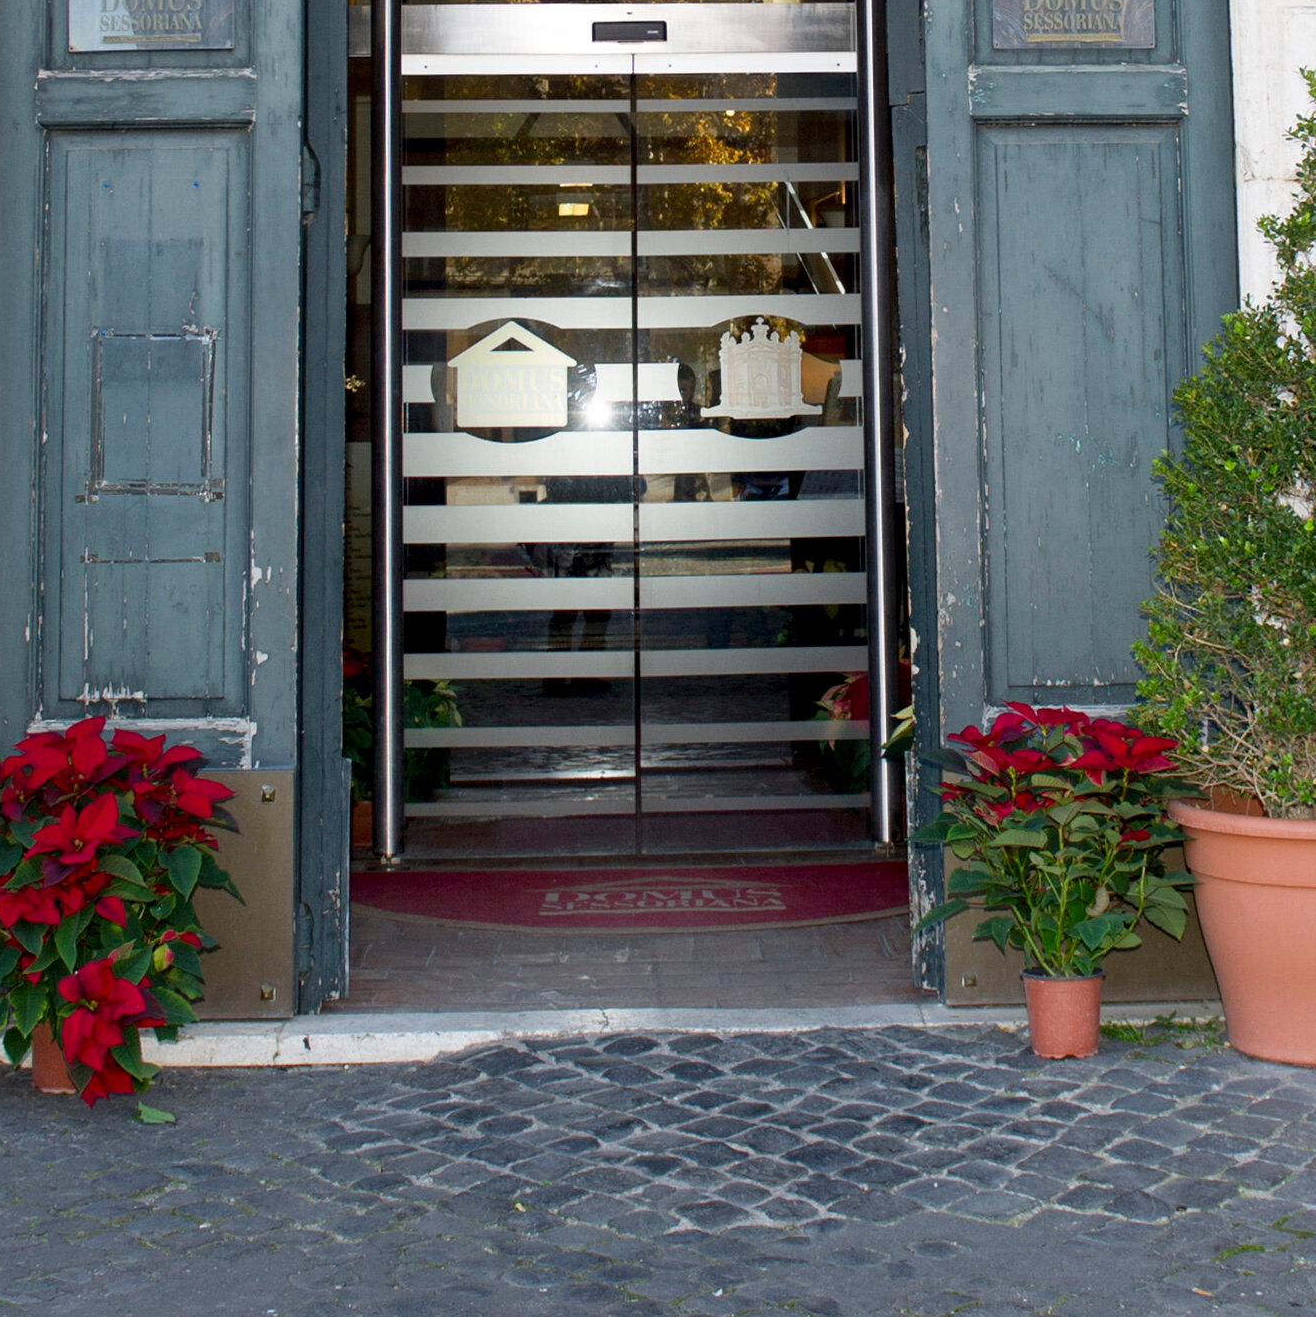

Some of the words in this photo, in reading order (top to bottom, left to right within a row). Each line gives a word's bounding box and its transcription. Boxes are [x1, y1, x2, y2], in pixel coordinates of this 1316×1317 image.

[100, 13, 203, 32] SESSORIANA
[1023, 12, 1123, 30] SESSORIANA
[461, 369, 564, 391] DOMUS
[544, 889, 782, 902] DOMUS
